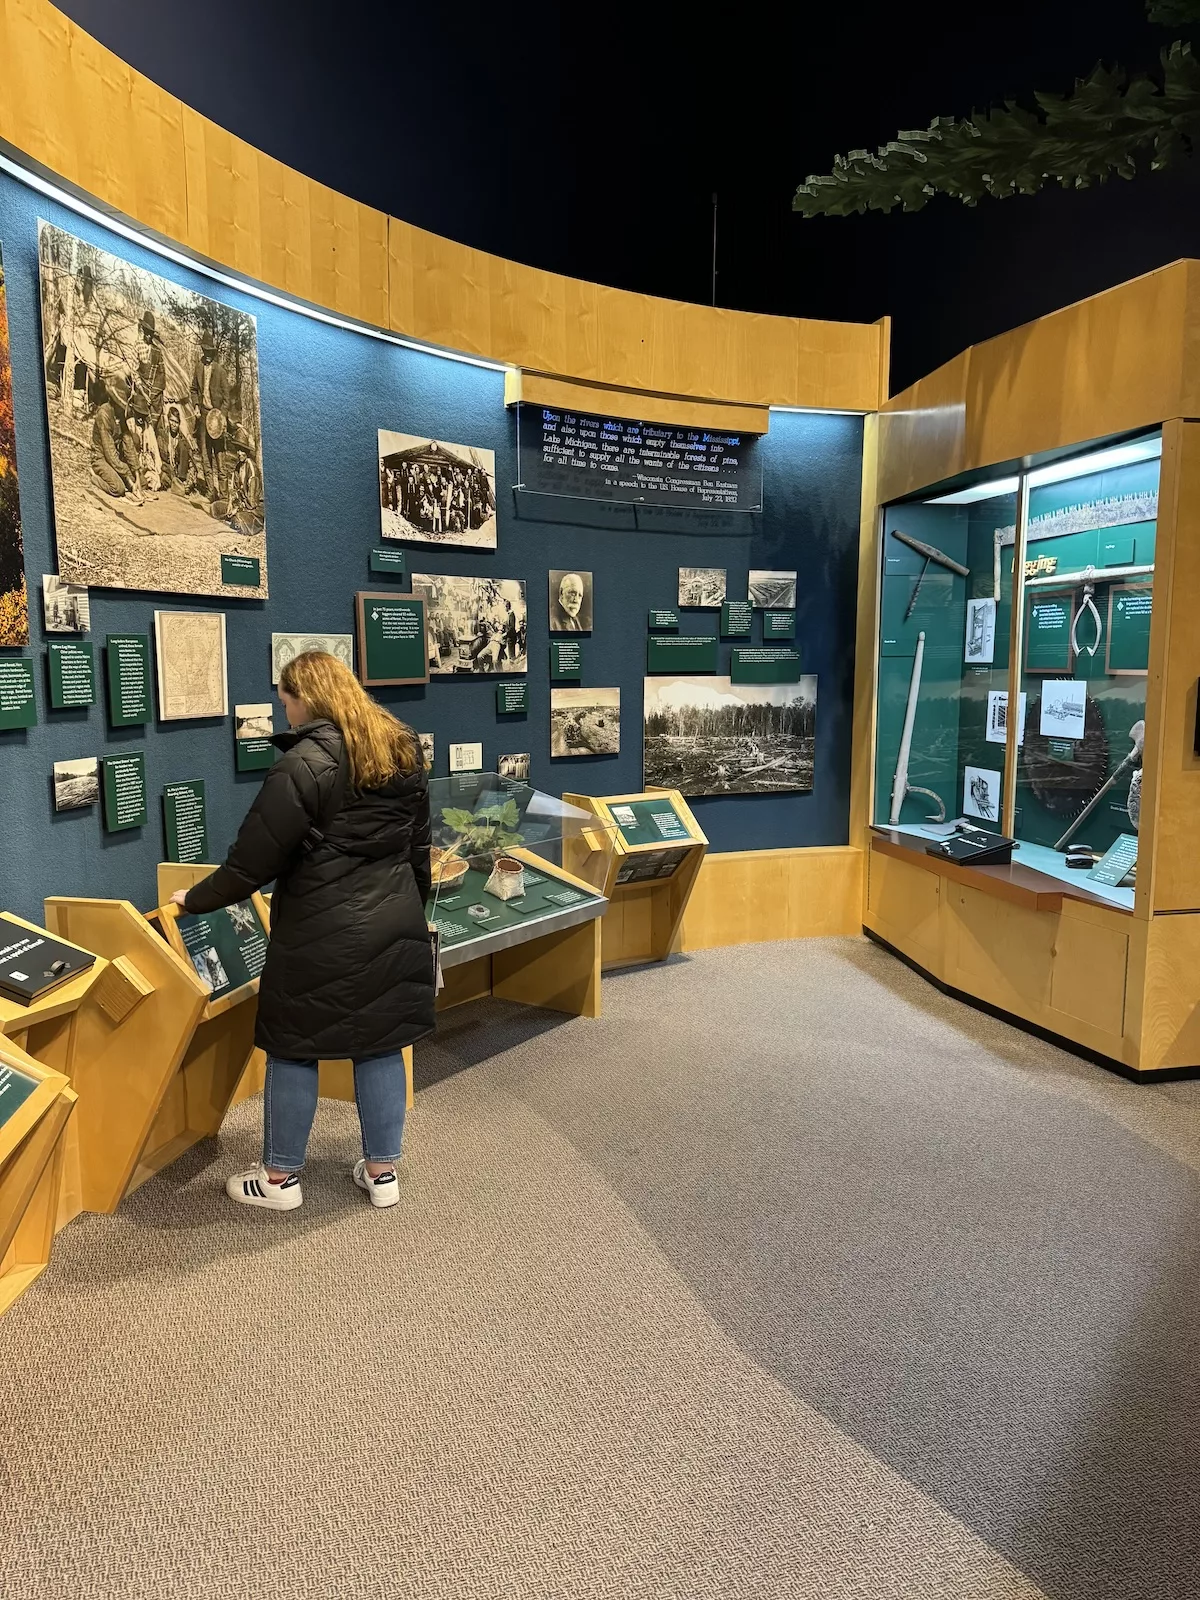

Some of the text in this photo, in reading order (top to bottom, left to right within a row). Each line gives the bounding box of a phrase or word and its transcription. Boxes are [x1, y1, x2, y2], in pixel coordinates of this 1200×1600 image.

[543, 410, 560, 421] Upon
[564, 415, 576, 424] the
[580, 419, 600, 429] rivers
[603, 421, 623, 432] which
[642, 427, 673, 439] tributary
[677, 431, 684, 439] to
[687, 432, 699, 441] the
[543, 422, 724, 453] and also upon those which empty themselves into
[543, 432, 739, 466] Lake Michigan, there are interminable forests of pine,
[543, 444, 575, 456] sufficient
[579, 449, 585, 457] to
[589, 451, 611, 462] supply
[615, 454, 625, 463] all
[629, 456, 640, 465] the
[644, 459, 663, 468] wants
[667, 460, 674, 469] of
[678, 461, 690, 470] the
[693, 463, 719, 472] citizens
[543, 453, 554, 463] for
[558, 456, 568, 465] all
[571, 458, 587, 468] time
[590, 461, 597, 469] to
[647, 482, 657, 490] the
[670, 484, 688, 492] House
